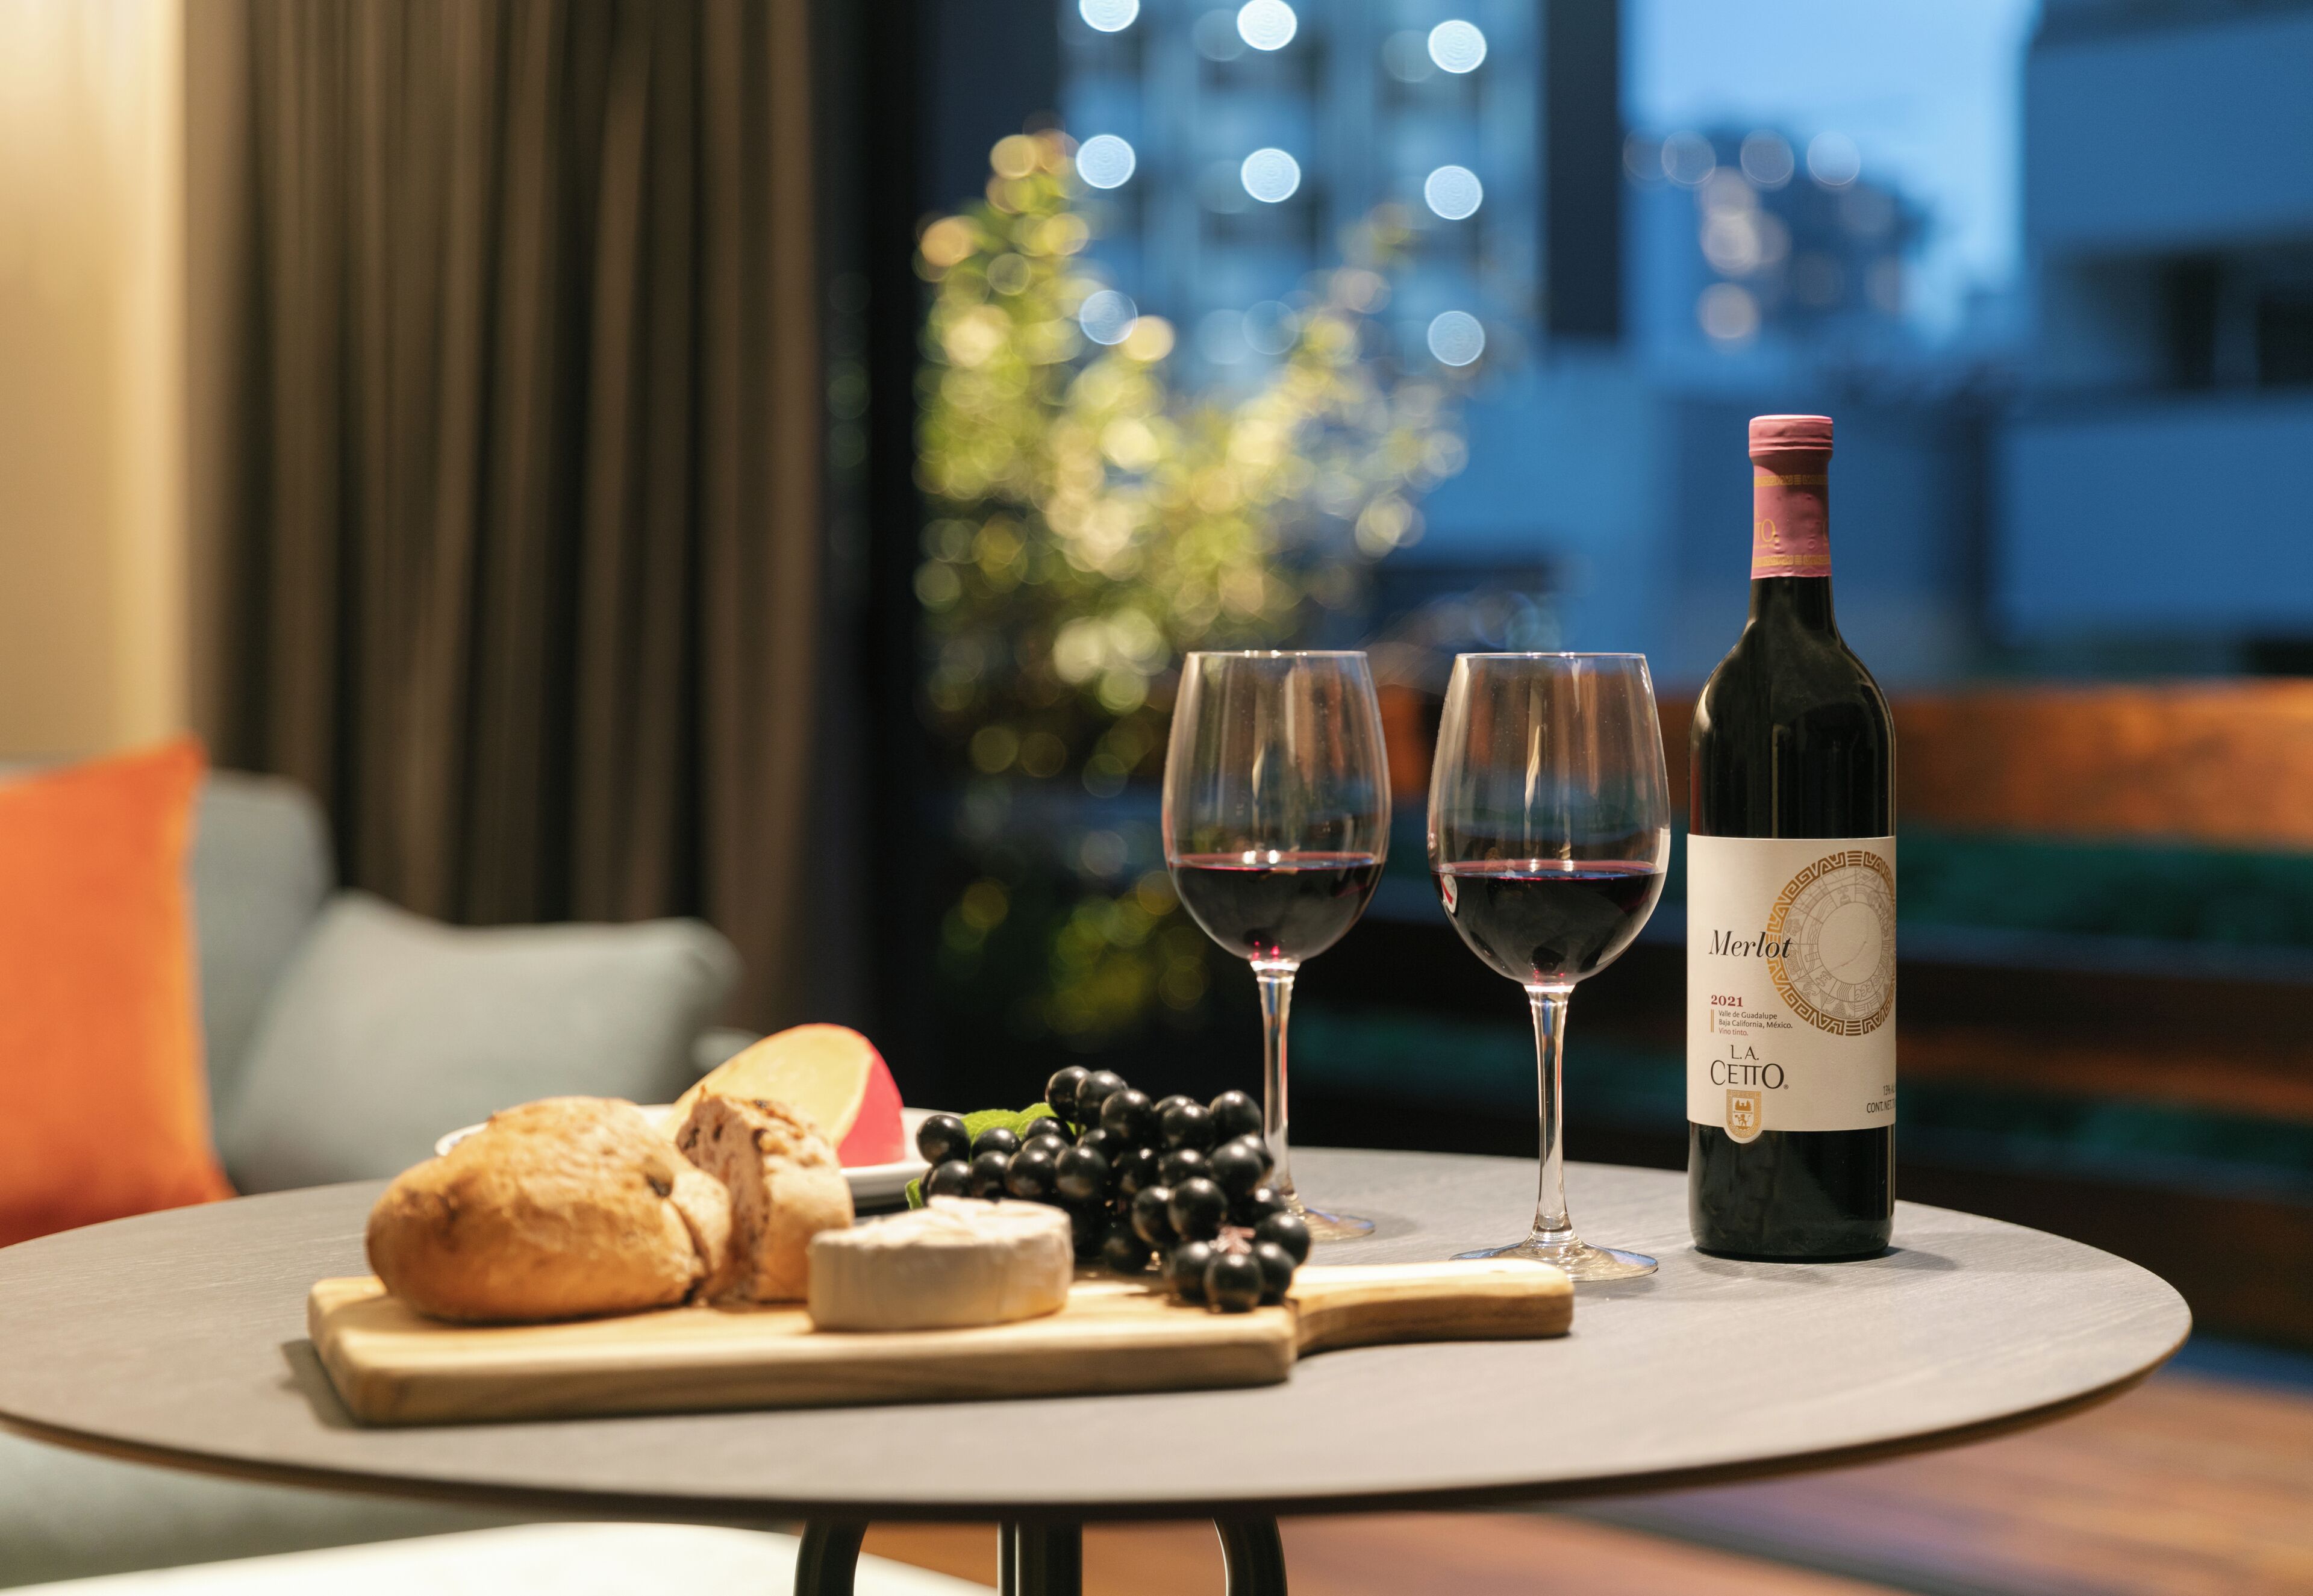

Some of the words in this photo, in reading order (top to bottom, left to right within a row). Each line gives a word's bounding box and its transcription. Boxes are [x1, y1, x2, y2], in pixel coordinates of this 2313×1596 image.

[1708, 929, 1793, 958] Merlot
[1711, 994, 1743, 1007] 2021
[1741, 1012, 1778, 1020] Guadalupe
[1732, 1020, 1765, 1029] California,
